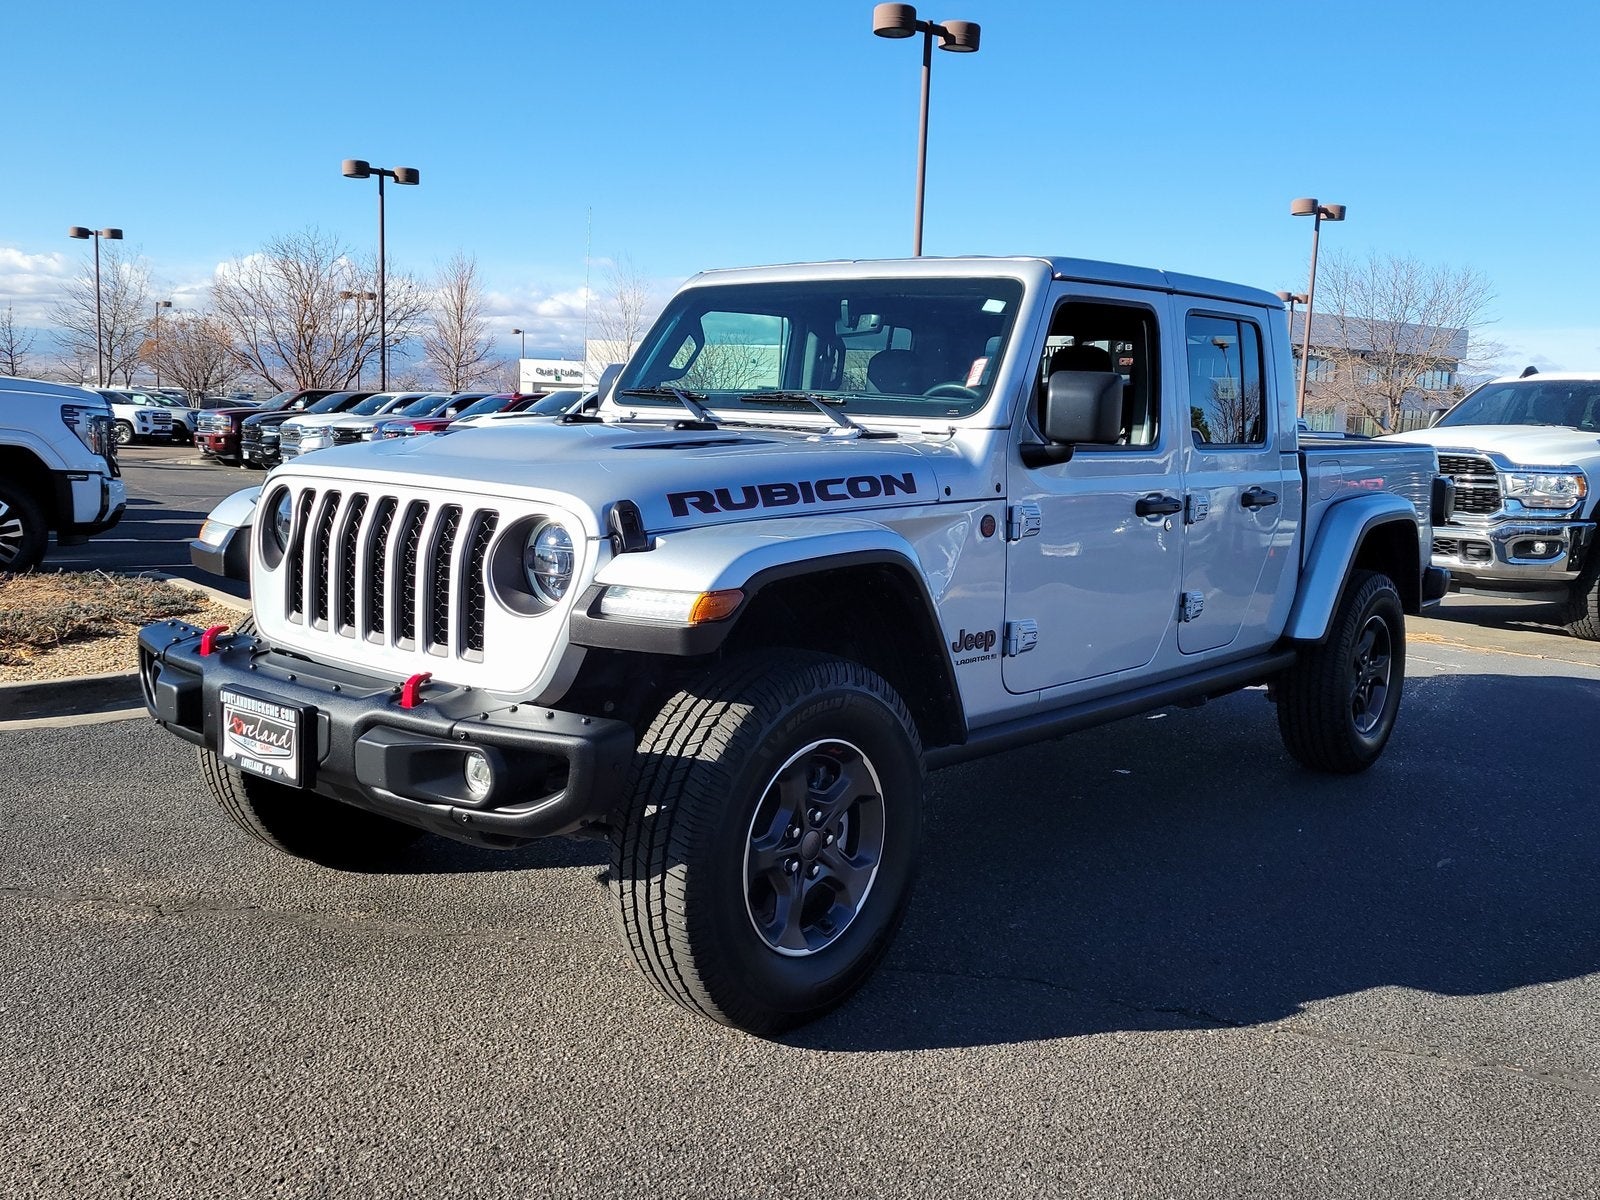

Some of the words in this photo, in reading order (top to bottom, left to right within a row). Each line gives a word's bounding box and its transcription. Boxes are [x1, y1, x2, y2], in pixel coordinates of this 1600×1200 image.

[536, 367, 558, 376] Quick
[667, 473, 917, 517] RUBICON
[952, 629, 996, 653] Jeep
[227, 710, 291, 748] Loveland
